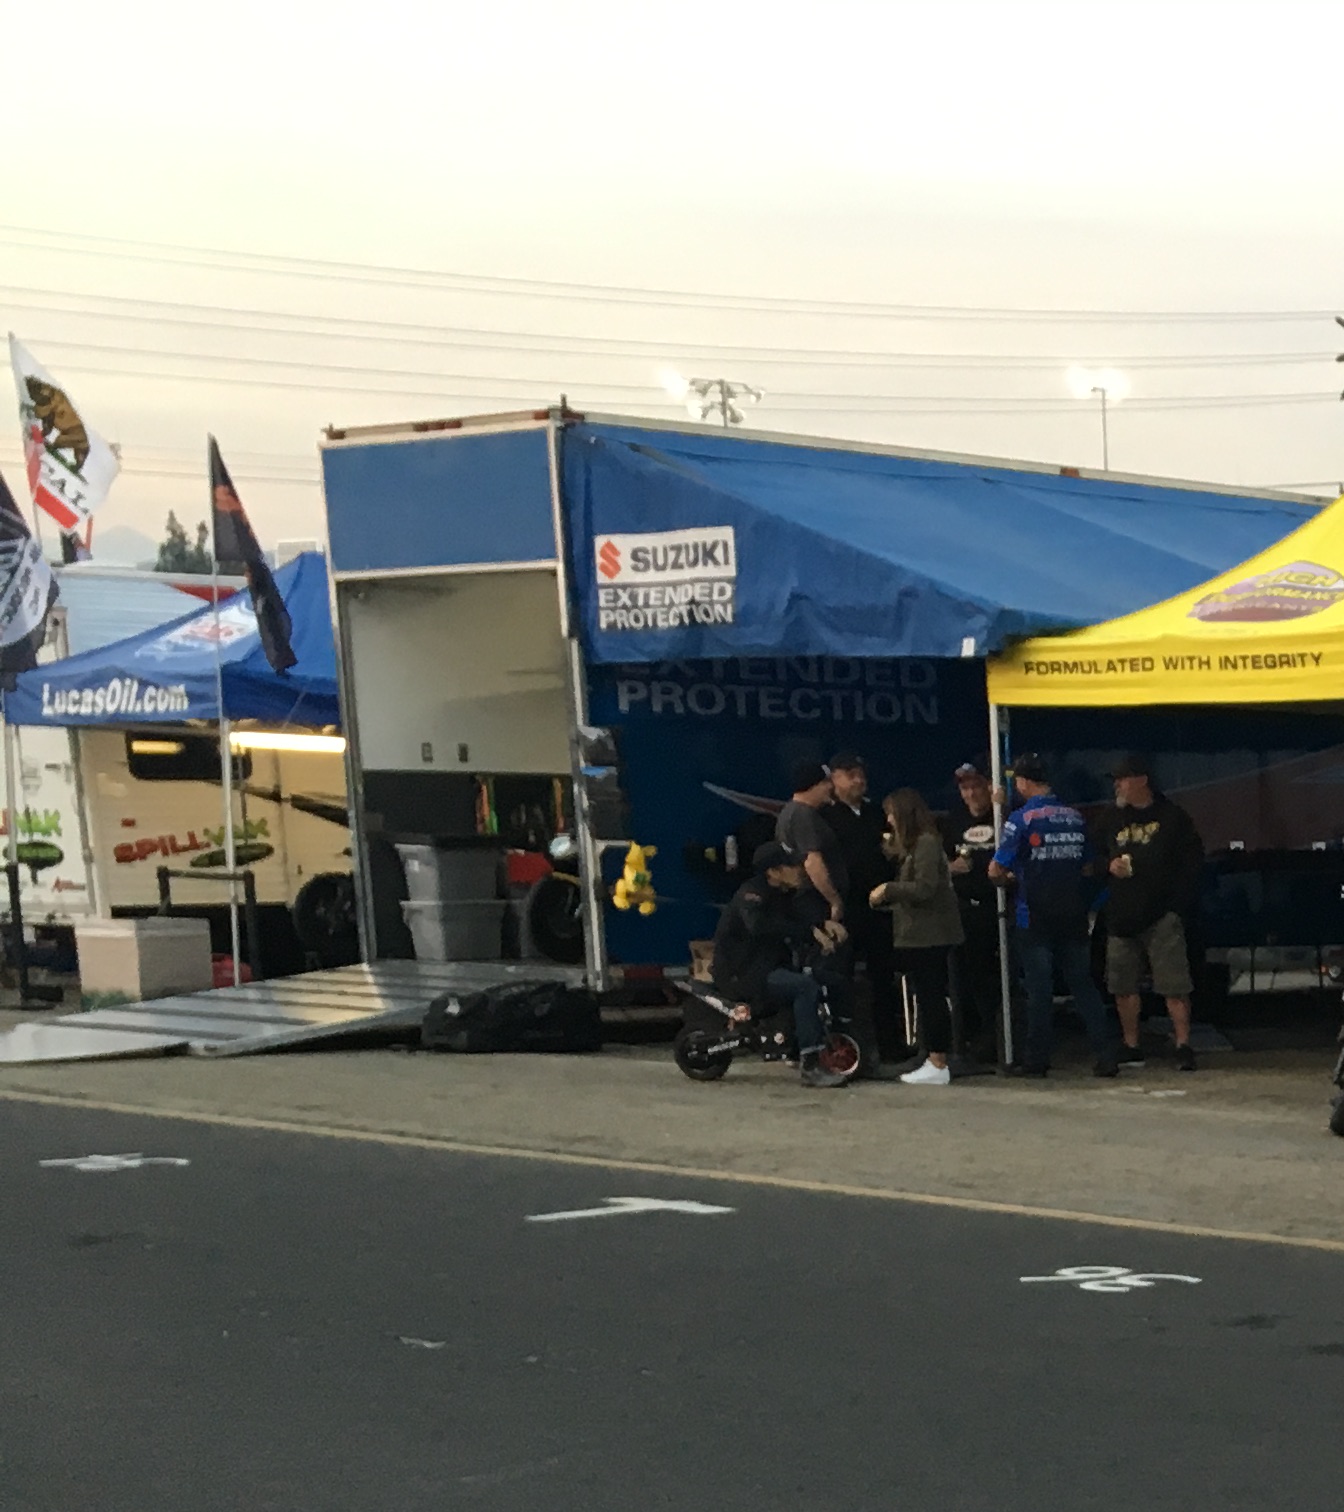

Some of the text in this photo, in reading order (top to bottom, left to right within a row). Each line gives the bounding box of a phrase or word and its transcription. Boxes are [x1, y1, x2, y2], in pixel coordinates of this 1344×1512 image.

[630, 539, 730, 572] SUZUKI
[599, 582, 733, 607] EXTENDED
[600, 603, 733, 630] PROTECTION
[1024, 651, 1323, 676] FORMULATED WITH INTEGRITY
[41, 677, 190, 717] LucasOil.com
[617, 679, 938, 724] PROTECTION
